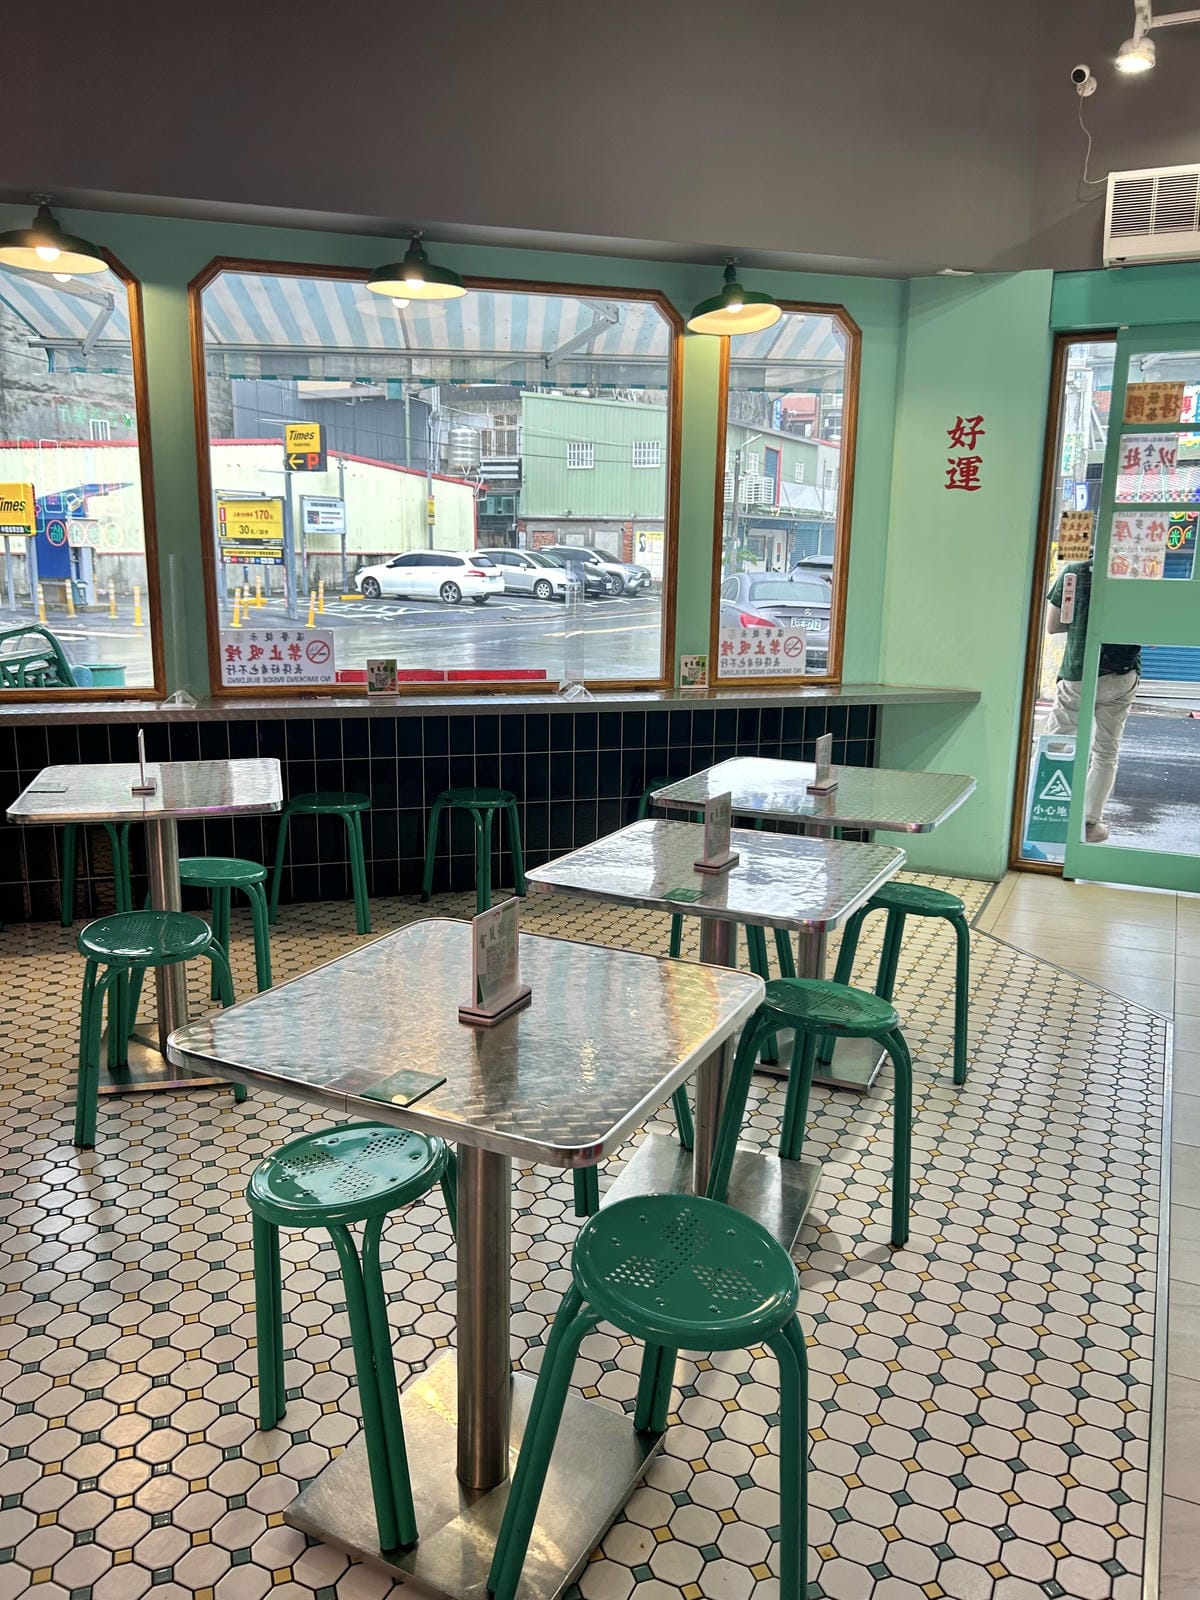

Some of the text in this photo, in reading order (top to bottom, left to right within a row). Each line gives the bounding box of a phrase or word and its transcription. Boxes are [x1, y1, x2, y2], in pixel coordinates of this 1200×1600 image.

[289, 430, 315, 440] Times
[944, 415, 986, 491] 好運
[306, 453, 320, 470] P
[0, 498, 26, 511] imes
[254, 510, 270, 520] 170
[1033, 804, 1068, 817] 小心地
